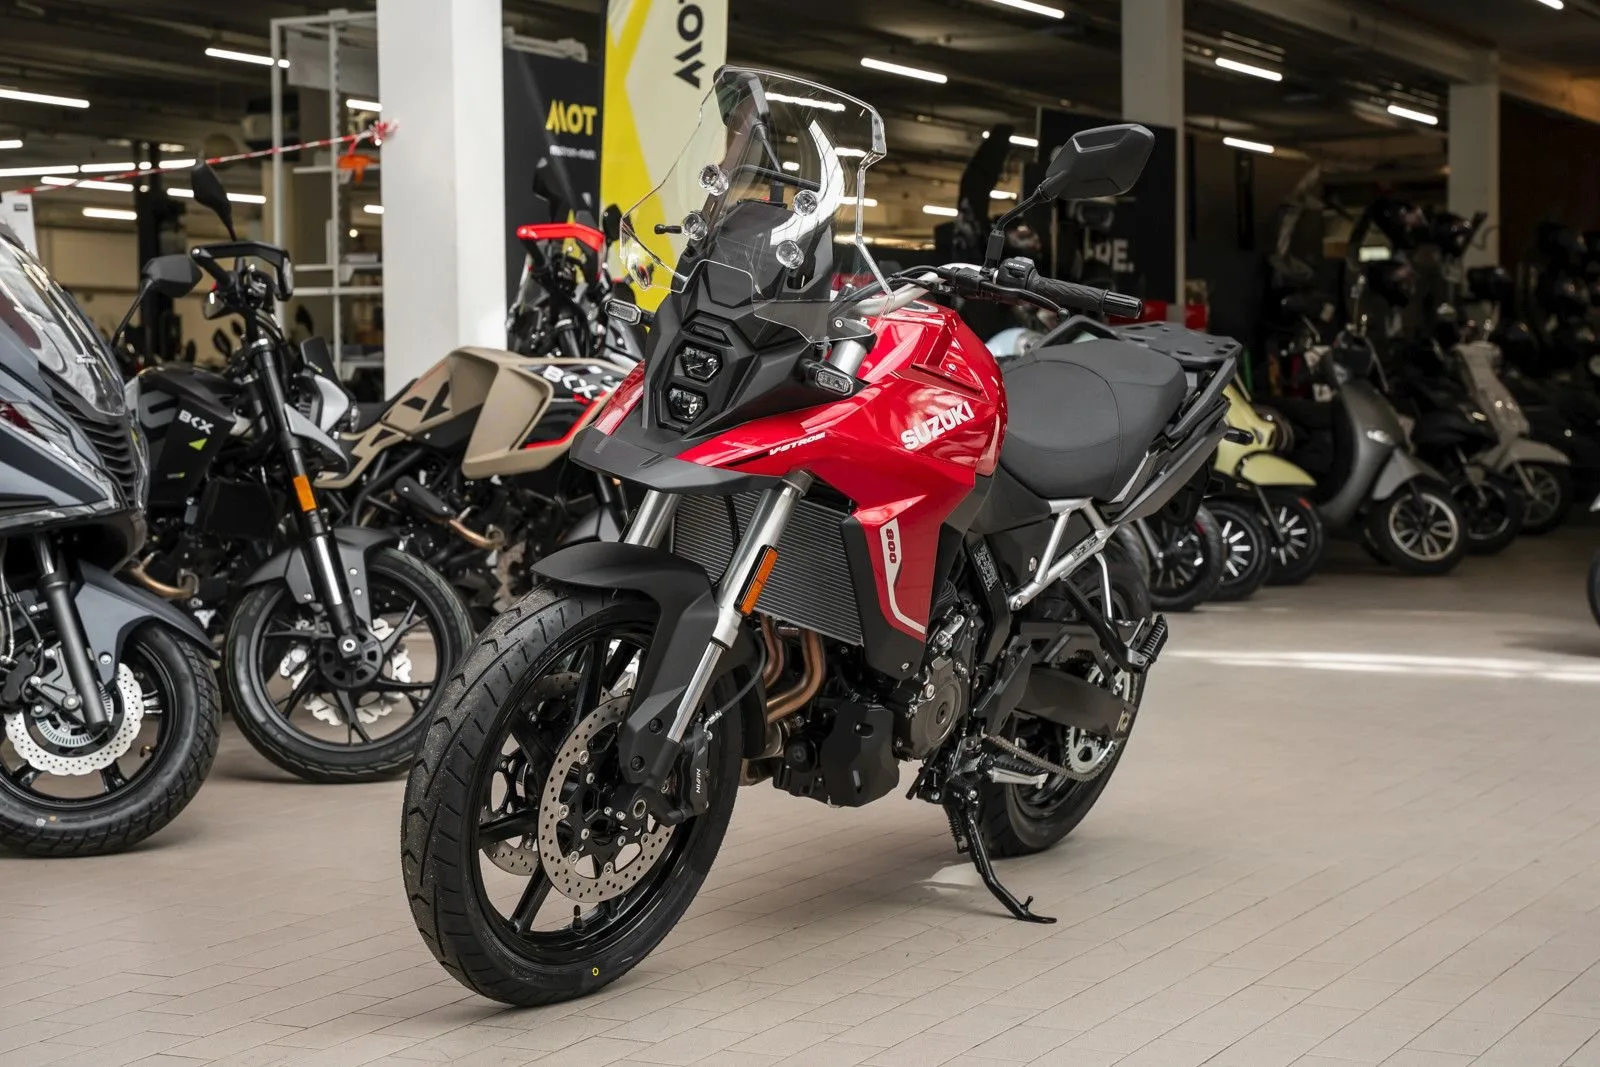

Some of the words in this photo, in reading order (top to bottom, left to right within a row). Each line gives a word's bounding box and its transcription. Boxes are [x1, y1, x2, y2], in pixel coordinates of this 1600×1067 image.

[674, 0, 705, 89] MO
[545, 99, 597, 136] MOT
[769, 432, 826, 456] V-STROM
[900, 401, 975, 450] SUZUKI
[886, 528, 897, 563] 800
